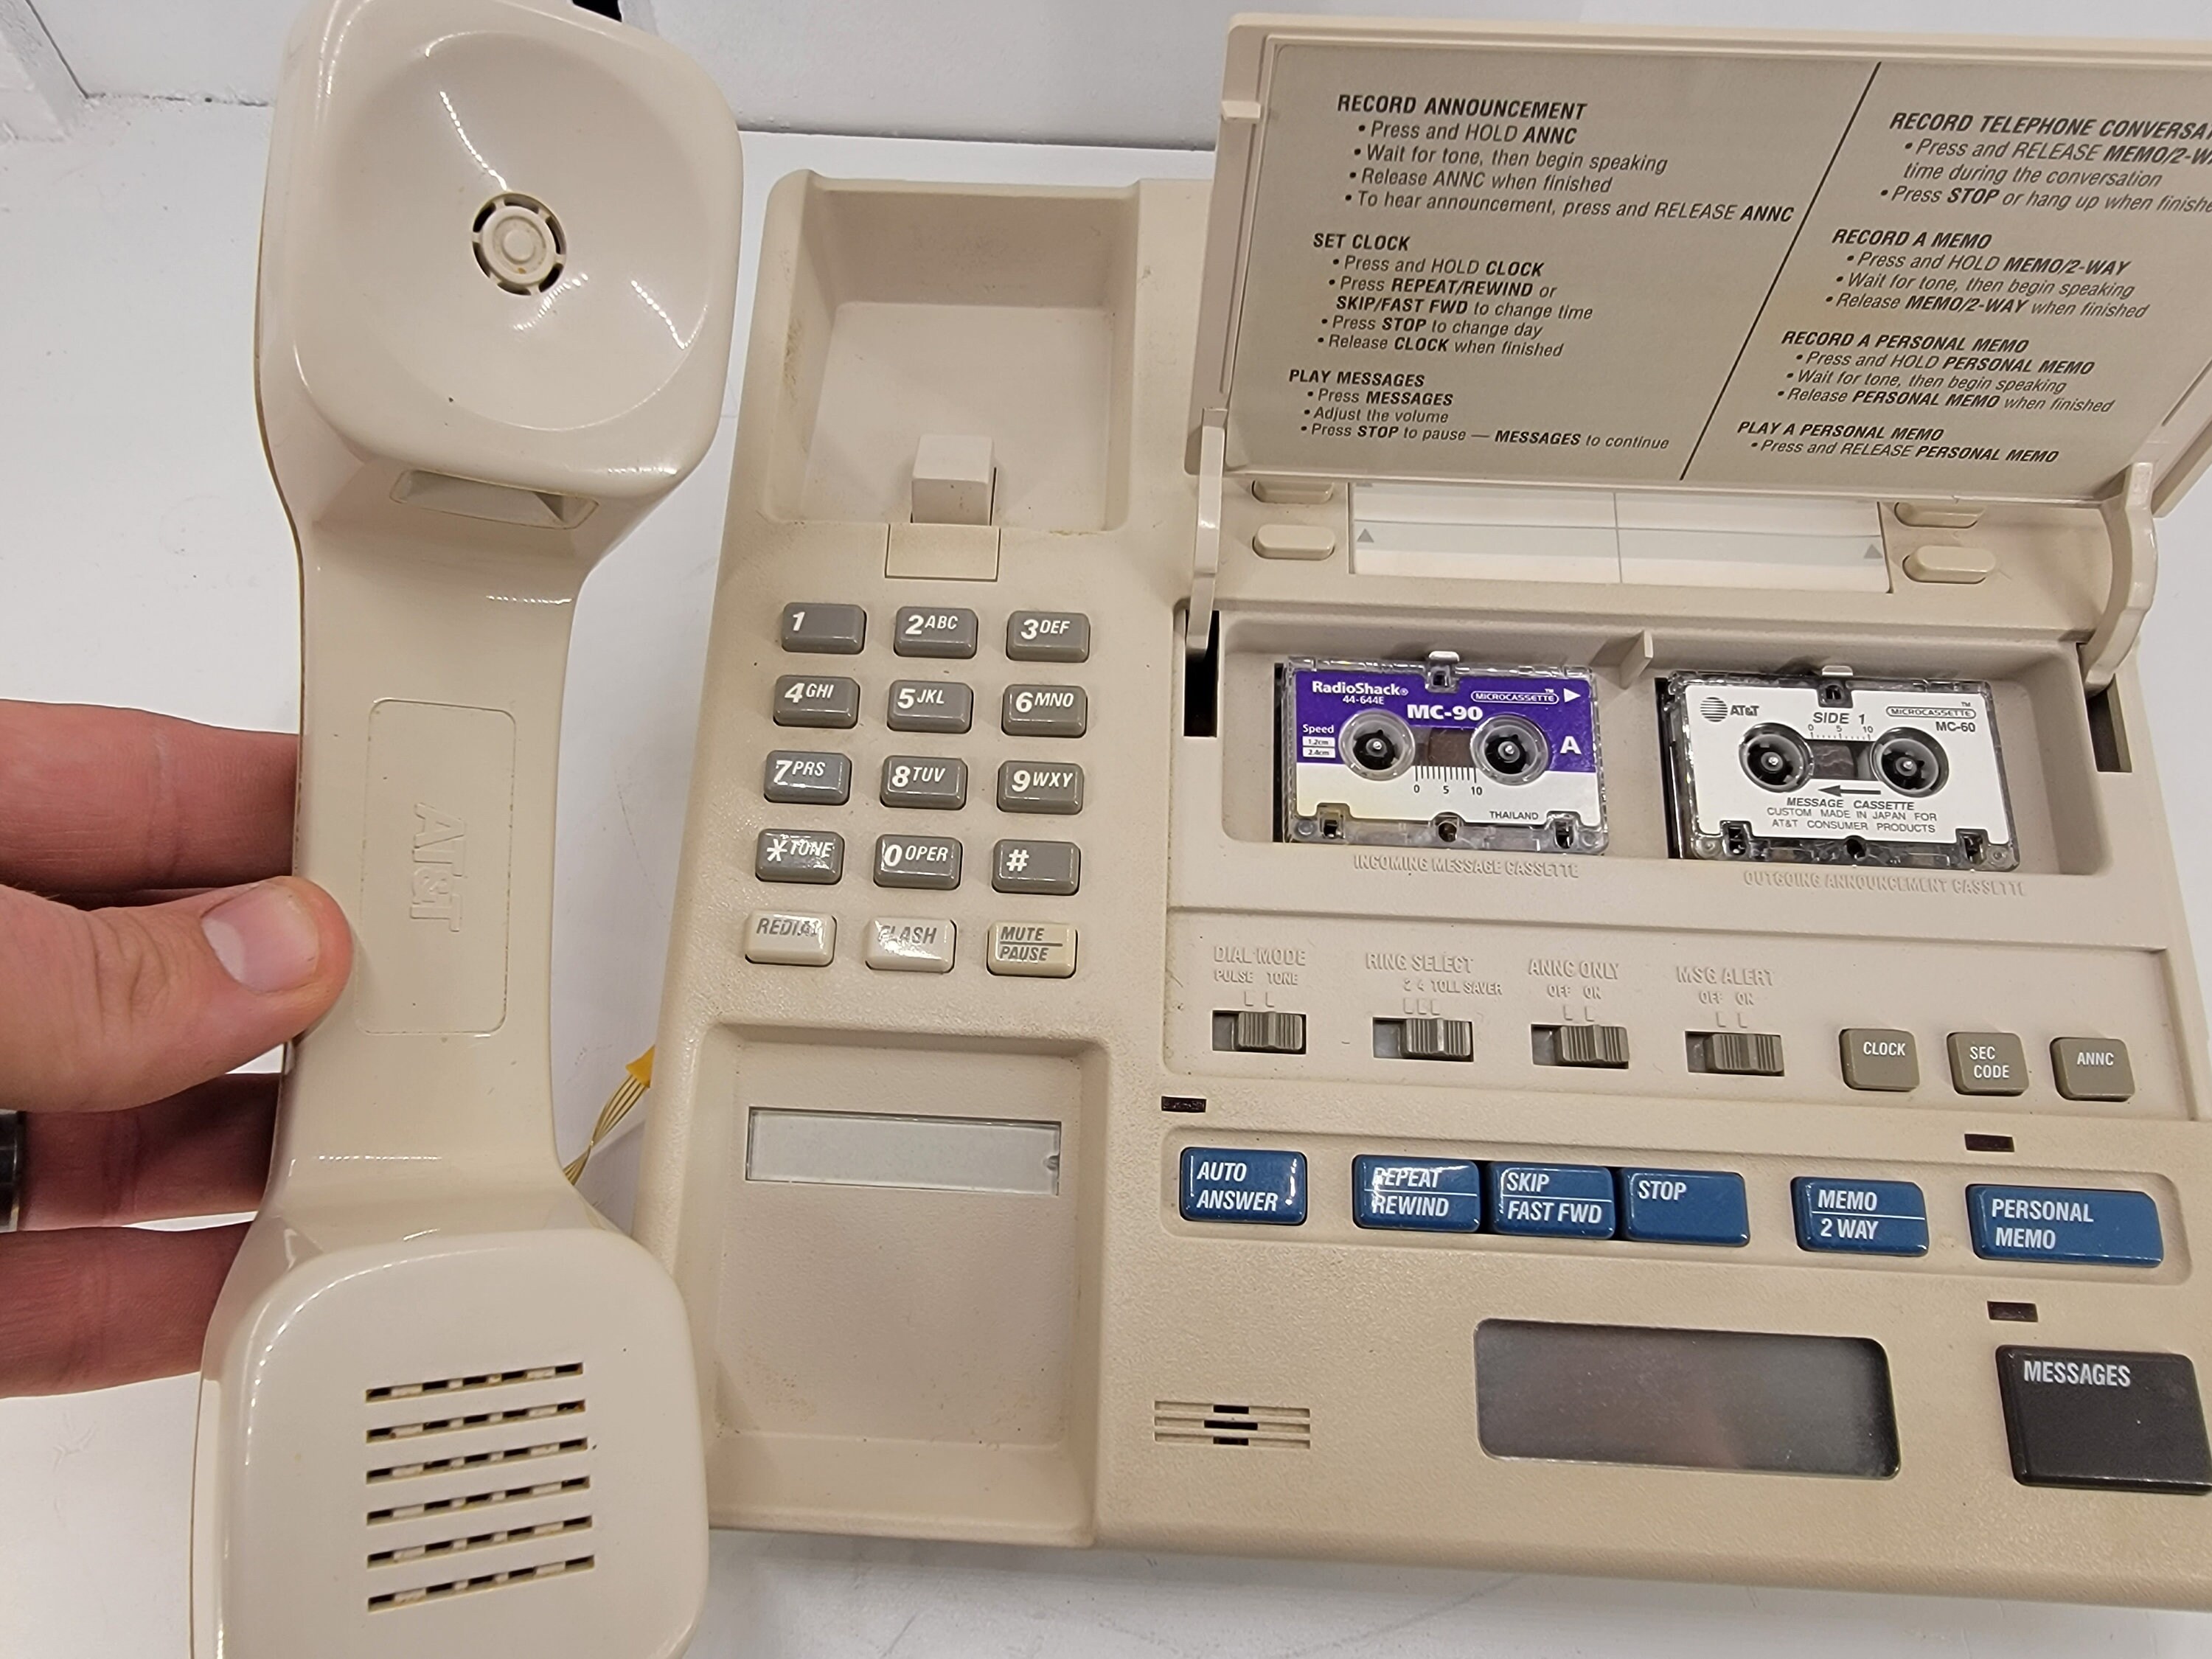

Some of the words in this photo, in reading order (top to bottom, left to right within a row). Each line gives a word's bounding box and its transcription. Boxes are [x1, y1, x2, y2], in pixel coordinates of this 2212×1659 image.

[1336, 94, 1416, 114] RECORD
[1422, 96, 1587, 120] ANNOUNCEMENT
[1370, 119, 1420, 139] Press
[1425, 122, 1460, 140] and
[1464, 122, 1518, 142] HOLD
[1521, 125, 1577, 145] ANNC
[1888, 111, 1974, 131] RECORD
[1978, 114, 2098, 136] TELEPHONE
[1366, 143, 1405, 162] Wait
[1411, 145, 1436, 163] for
[1441, 147, 1483, 166] tone,
[1491, 147, 1529, 167] then
[1534, 149, 1584, 171] begin
[1588, 153, 1668, 175] speaking
[1360, 167, 1427, 186] Release
[1432, 169, 1486, 188] ANNC
[1491, 172, 1537, 190] when
[1542, 174, 1613, 193] finished
[1902, 162, 1944, 180] time
[1947, 163, 2008, 185] during
[2011, 165, 2042, 184] the
[2045, 170, 2163, 187] conversation
[1358, 189, 1378, 206] To
[1383, 190, 1422, 208] hear
[1425, 195, 1555, 215] announcement,
[1561, 201, 1611, 218] press
[1615, 201, 1650, 218] and
[1653, 201, 1738, 220] RELEASE
[1739, 204, 1795, 222] ANNC
[1312, 232, 1346, 249] SET
[1351, 233, 1411, 251] CLOCK
[1830, 228, 1910, 246] RECORD
[1910, 231, 1927, 247] A
[1930, 232, 1992, 249] MEMO
[1343, 254, 1390, 271] Press
[1394, 257, 1426, 273] and
[1430, 257, 1480, 274] HOLD
[1485, 260, 1545, 277] CLOCK
[1857, 251, 1906, 268] Press
[1909, 253, 1946, 269] and
[1946, 254, 2000, 271] HOLD
[2002, 256, 2132, 276] MEMO/2-WAY
[1339, 275, 1385, 291] Press
[1390, 276, 1534, 297] REPEAT/REWIND
[1538, 285, 1558, 298] or
[1780, 330, 1854, 347] RECORD
[1856, 333, 1871, 348] A
[1874, 333, 1966, 351] PERSONAL
[1970, 337, 2030, 353] MEMO
[1288, 369, 1332, 383] PLAY
[1335, 370, 1425, 387] MESSAGES
[1317, 387, 1360, 403] Press
[1365, 389, 1454, 406] MESSAGES
[1736, 420, 1782, 434] PLAY
[1781, 422, 1795, 435] A
[1798, 423, 1885, 439] PERSONAL
[1889, 426, 1944, 441] MEMO
[1759, 439, 1804, 453] Press
[1806, 441, 1838, 454] and
[1839, 442, 1914, 457] RELEASE
[1914, 445, 2000, 461] PERSONAL
[2004, 448, 2059, 462] MEMO
[792, 612, 805, 631] 1
[1343, 695, 1384, 705] 44-644E
[1475, 692, 1554, 702] MICROCASSETTE
[1407, 704, 1484, 721] MC-90
[1730, 705, 1759, 716] AT&T
[1812, 712, 1849, 725] SIDE
[1859, 714, 1865, 726] 1
[1891, 708, 1971, 717] MICROCASSETTE
[1303, 724, 1335, 734] Speed
[1863, 726, 1874, 734] 10
[1935, 721, 1976, 733] MC-60
[1559, 736, 1582, 754] A
[1443, 786, 1450, 795] 5
[1471, 786, 1483, 796] 10
[1787, 797, 1843, 808] MESSAGE
[1853, 800, 1914, 810] CASSETTE
[1489, 811, 1539, 821] THAILAND
[1767, 807, 1812, 817] CUSTOM
[1820, 809, 1851, 818] MADE
[1857, 810, 1867, 819] IN
[1873, 811, 1906, 820] JAPAN
[1915, 813, 1937, 821] FOR
[1772, 819, 1798, 827] AT&T
[1807, 820, 1868, 830] CONSUMER
[1877, 823, 1935, 833] PRODUCTS
[409, 802, 466, 933] AT&T
[1001, 926, 1045, 941] MUTE
[1000, 947, 1049, 961] PAUSE
[1214, 946, 1252, 964] DIAL
[1257, 948, 1306, 967] MODE
[1366, 953, 1405, 971] RING
[1411, 956, 1473, 974] SELECT
[1214, 970, 1253, 984] PULSE
[1267, 973, 1298, 985] TONE
[1528, 959, 1575, 978] ANNC
[1579, 961, 1619, 981] ONLY
[1676, 966, 1718, 984] MSG
[1722, 968, 1775, 987] ALERT
[1431, 981, 1460, 993] TOLL
[1464, 982, 1503, 995] SAVER
[1548, 985, 1571, 998] OFF
[1583, 987, 1601, 1000] ON
[1699, 991, 1723, 1004] OFF
[1736, 992, 1754, 1006] ON
[1863, 1042, 1906, 1057] CLOCK
[1969, 1046, 1995, 1060] SEC
[2076, 1051, 2114, 1066] ANNC
[1973, 1065, 2010, 1079] CODE
[1196, 1161, 1247, 1182] AUTO
[1373, 1167, 1441, 1189] REPEAT
[1506, 1172, 1549, 1192] SKIP
[1637, 1180, 1686, 1203] STOP
[1196, 1191, 1279, 1212] ANSWER
[1373, 1194, 1450, 1217] REWIND
[1818, 1189, 1878, 1212] MEMO
[1992, 1198, 2094, 1222] PERSONAL
[1507, 1200, 1554, 1220] FAST
[1557, 1203, 1602, 1223] FWD
[1820, 1218, 1834, 1238] 2
[1837, 1219, 1881, 1240] WAY
[1995, 1228, 2056, 1251] MEMO
[2023, 1360, 2131, 1388] MESSAGES
